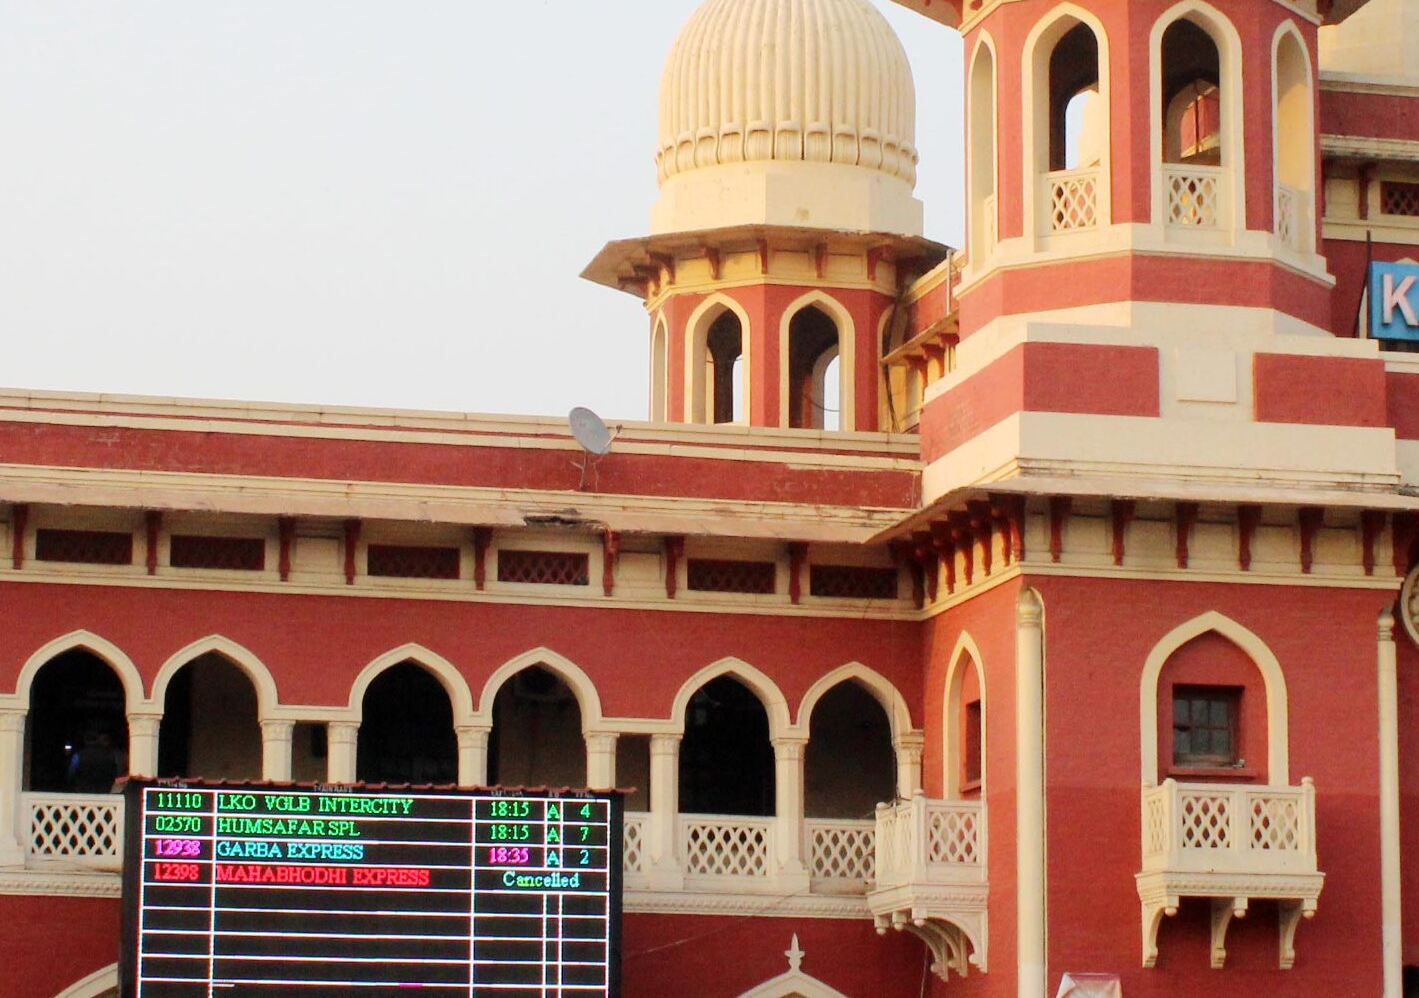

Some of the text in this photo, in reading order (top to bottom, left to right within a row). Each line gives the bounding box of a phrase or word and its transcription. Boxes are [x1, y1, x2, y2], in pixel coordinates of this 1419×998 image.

[158, 792, 591, 819] 11110 LKO VGLB INTERCITY 18:15 A 4
[155, 816, 591, 843] 02570 HUMSAFAR SPL 18:15 A 7
[154, 838, 591, 866] 12938 GARBA EXPRESS 18:35 A 2
[153, 862, 581, 889] 12398 MAHABHODHI EXPRESS Cancelled
